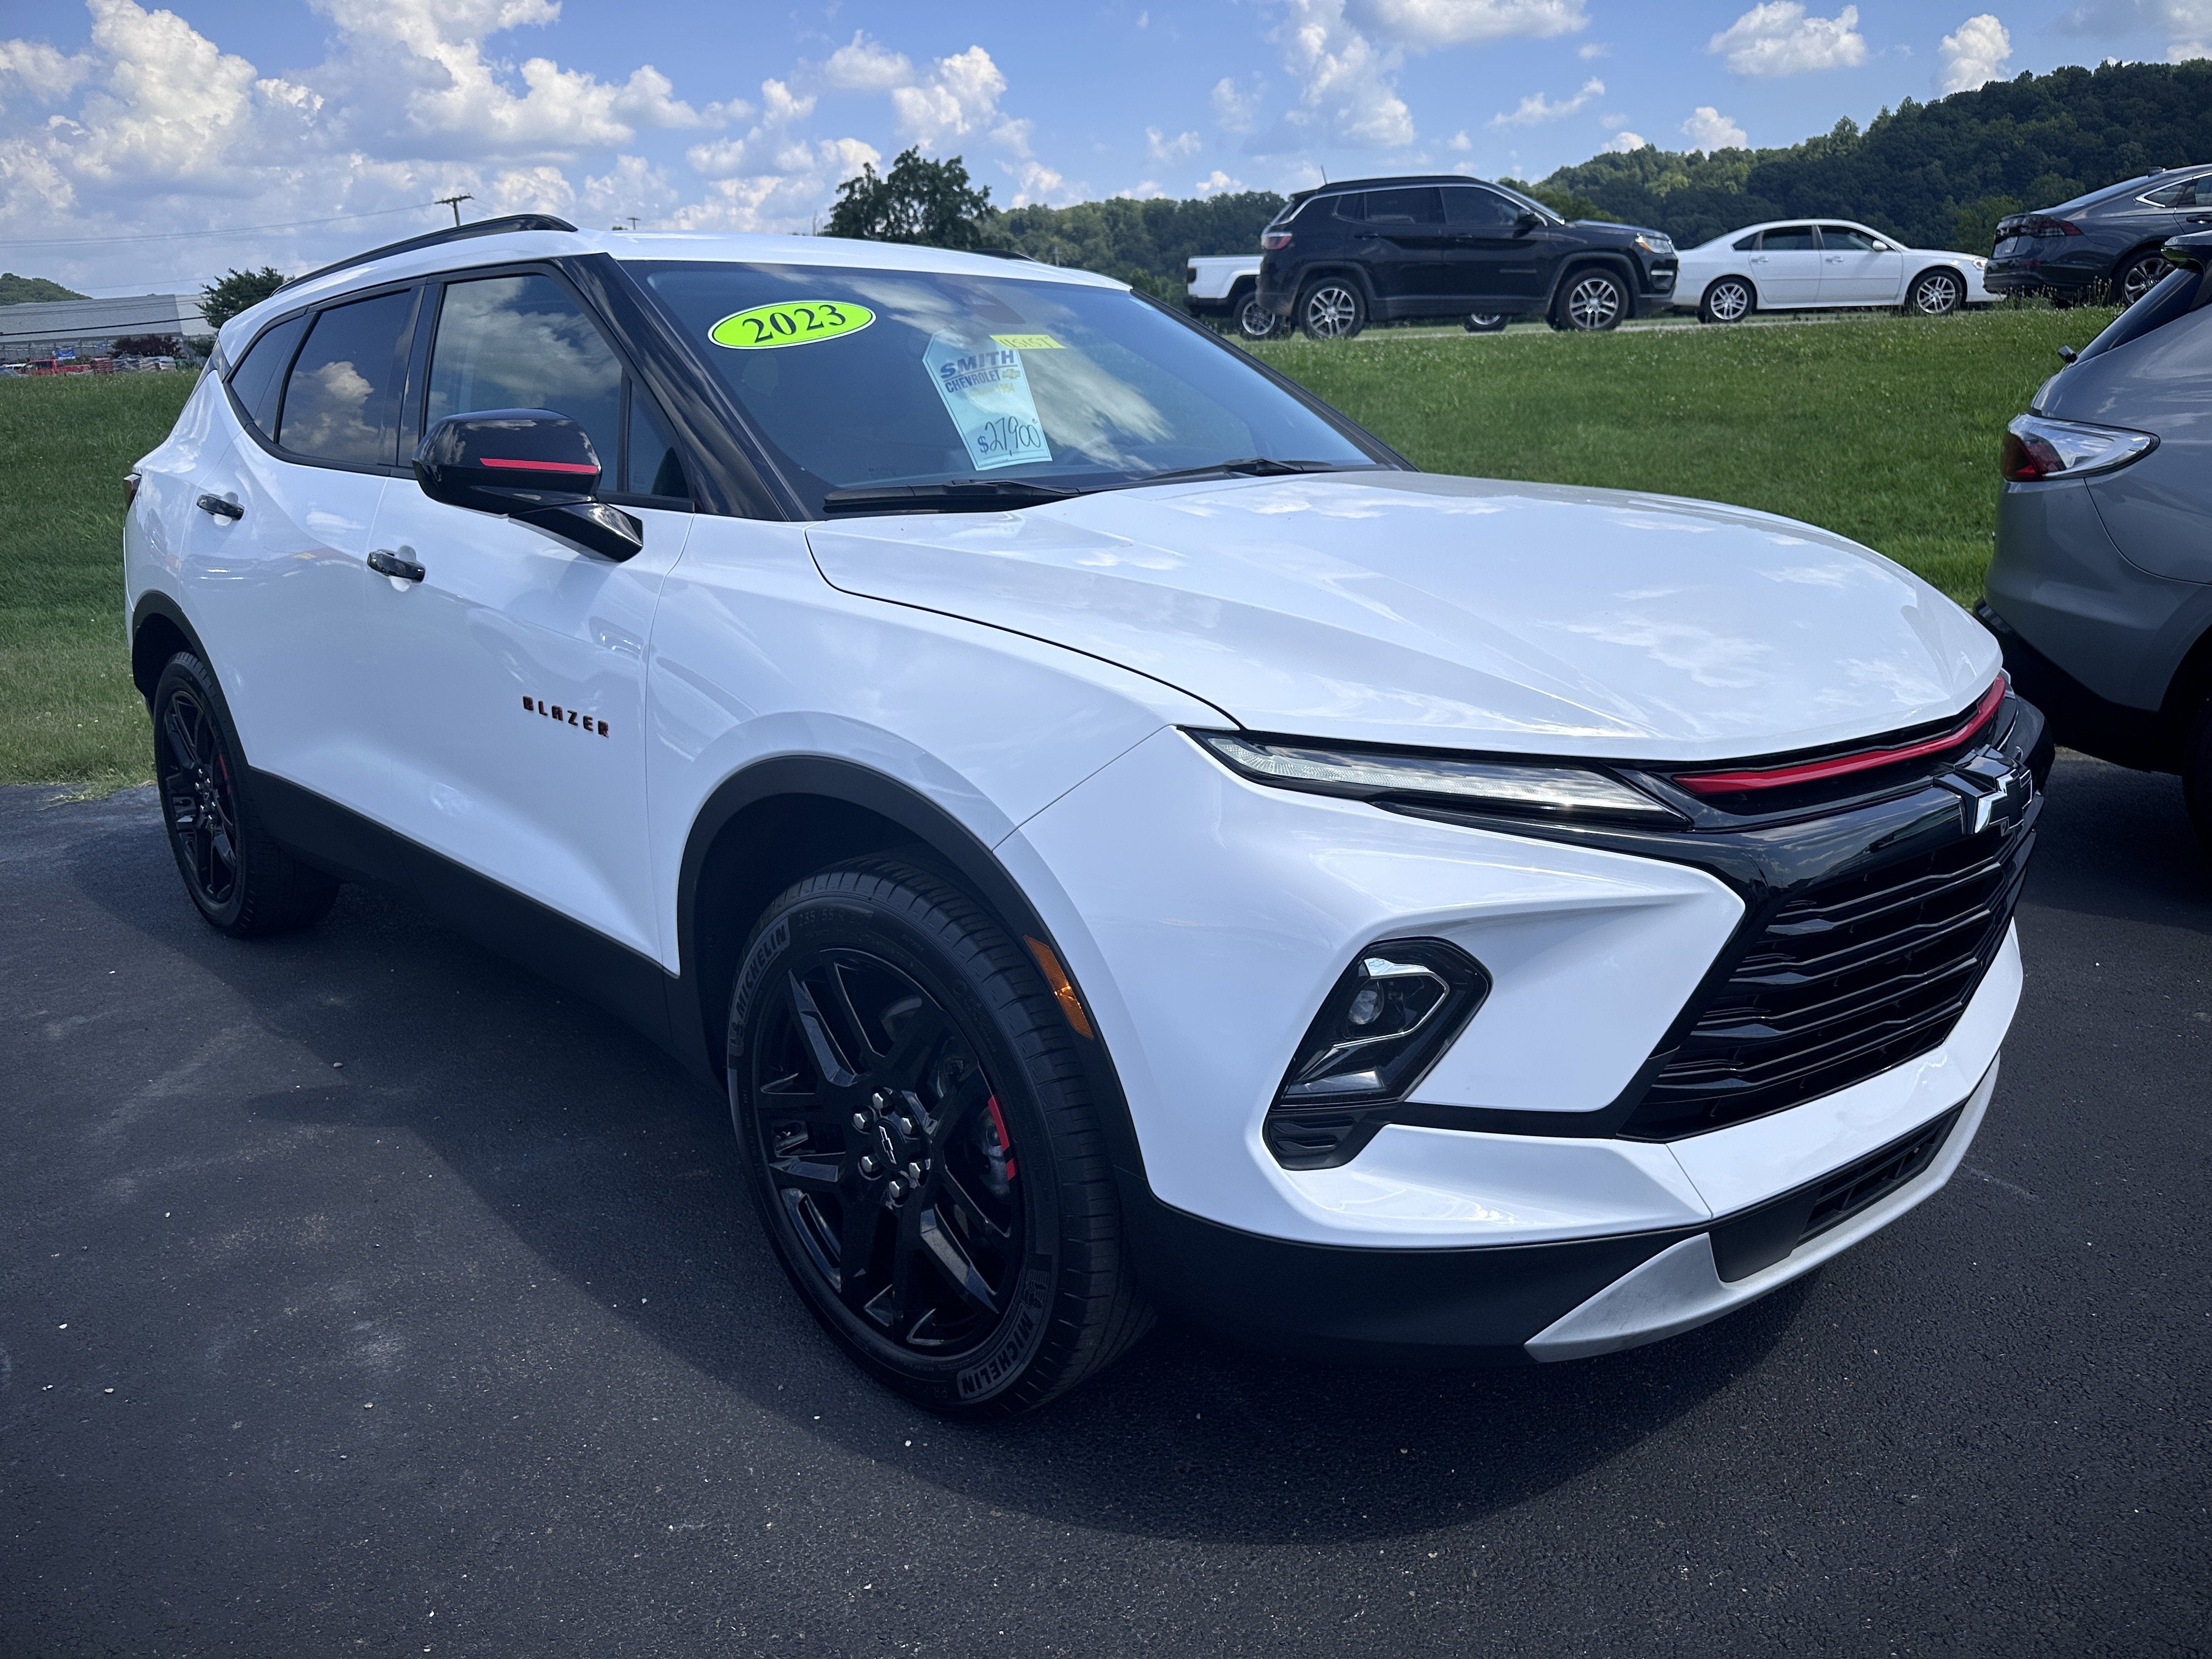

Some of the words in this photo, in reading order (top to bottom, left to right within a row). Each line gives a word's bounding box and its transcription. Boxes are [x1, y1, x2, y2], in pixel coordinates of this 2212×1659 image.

[742, 304, 846, 343] 2023
[940, 350, 1014, 379] SMITH
[945, 369, 1001, 393] CHEVROLET
[523, 696, 609, 738] BLAZER
[799, 908, 834, 927] 235/55
[736, 924, 787, 1017] MICHELIN
[961, 1310, 1034, 1394] MICHELIN
